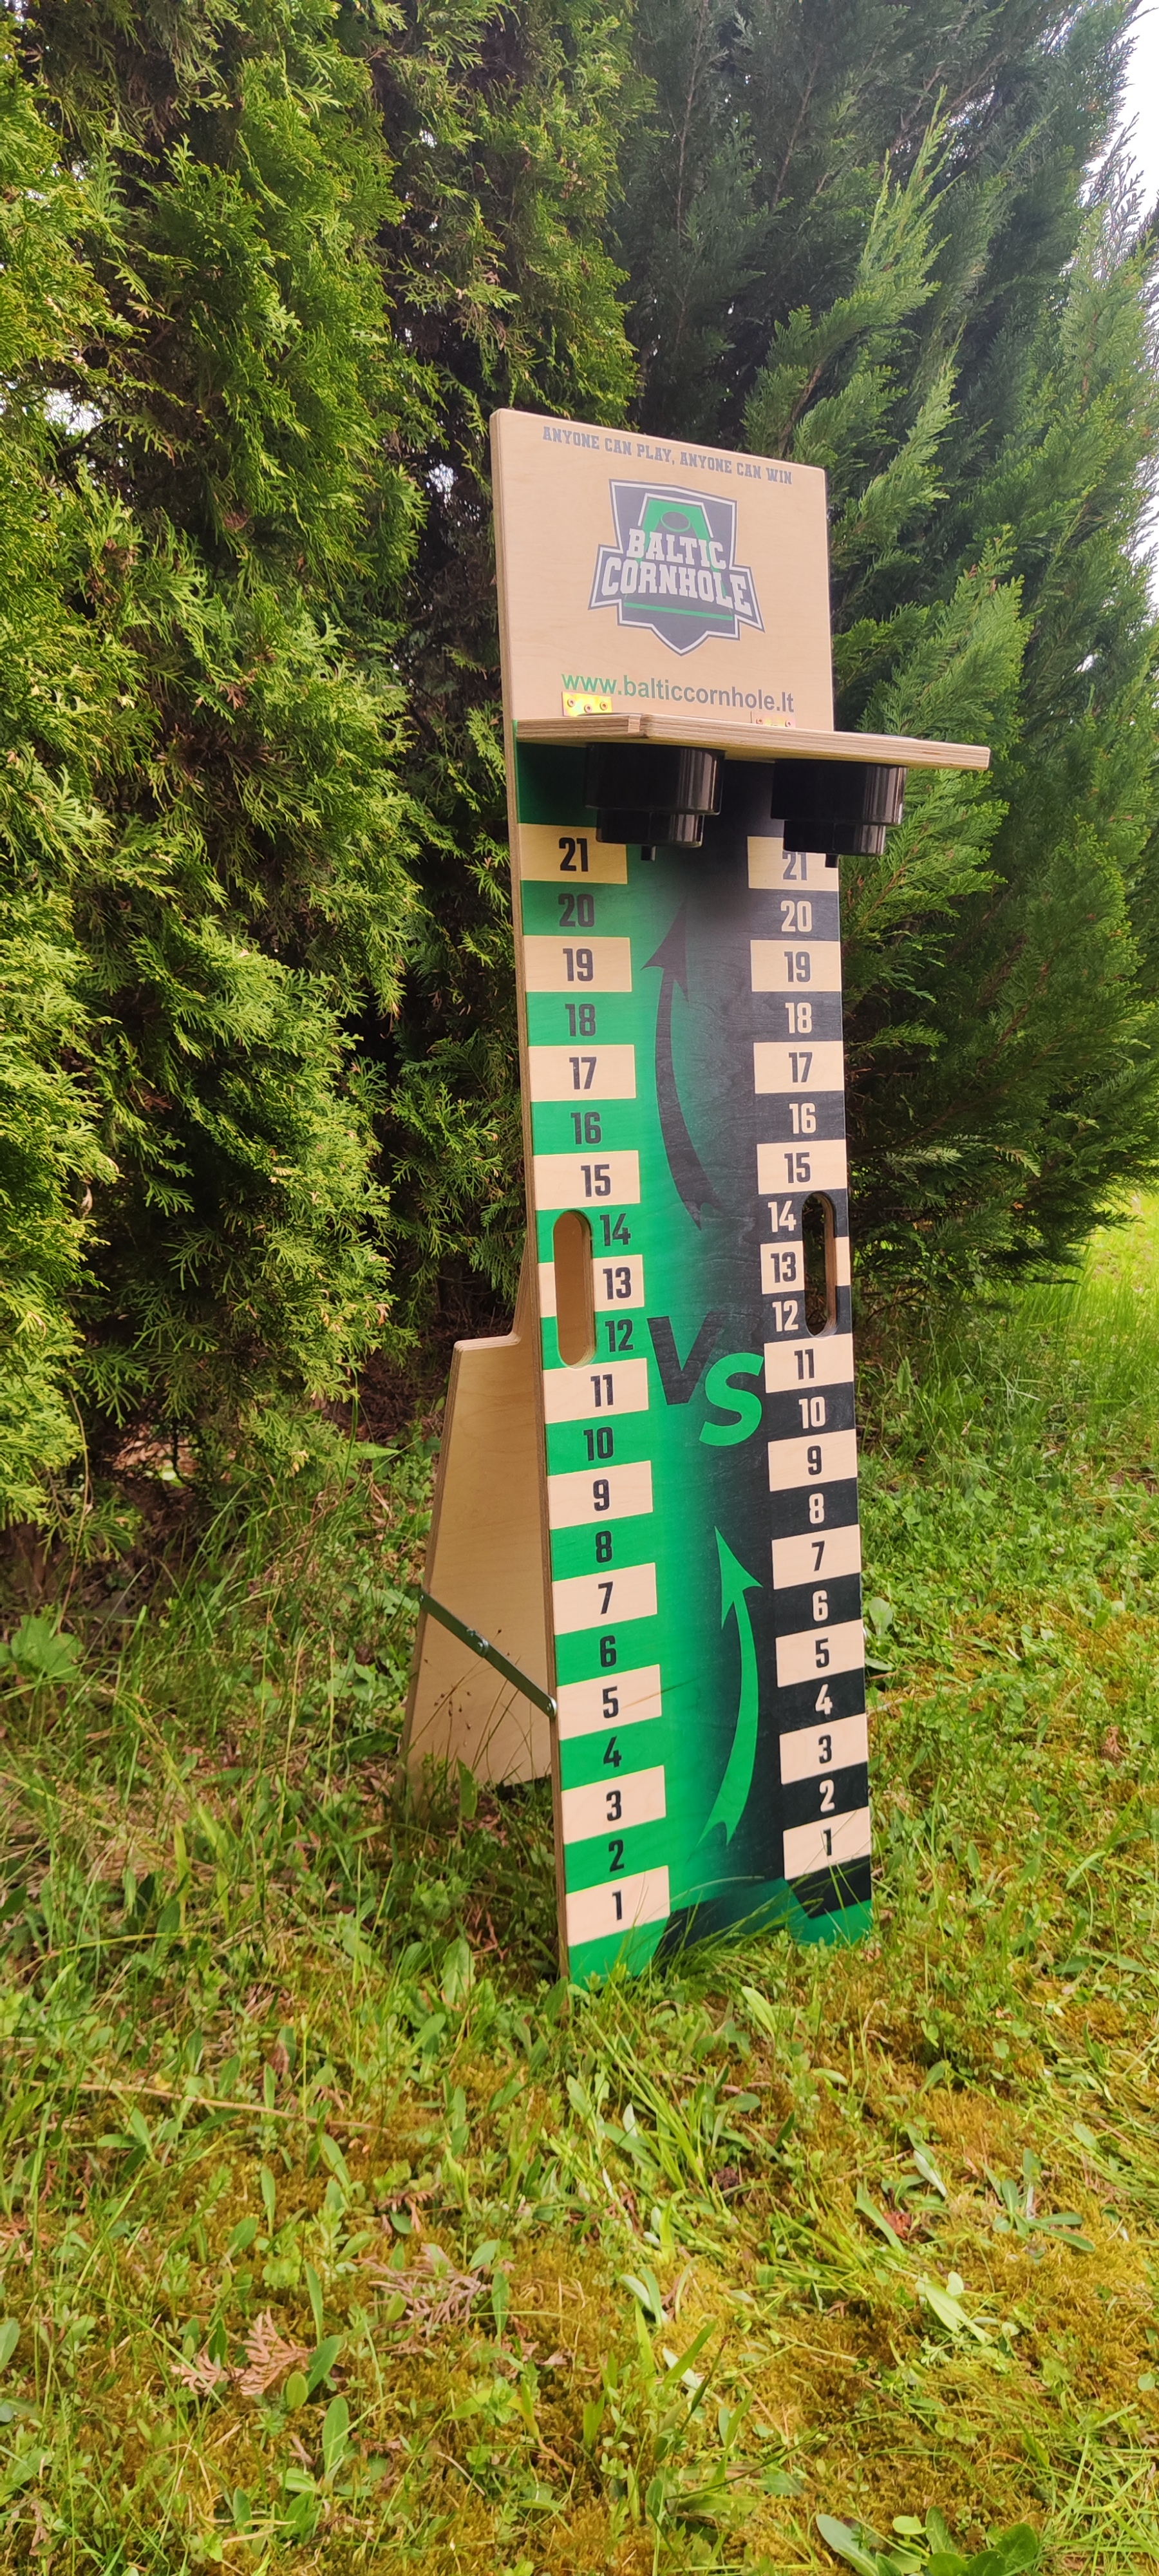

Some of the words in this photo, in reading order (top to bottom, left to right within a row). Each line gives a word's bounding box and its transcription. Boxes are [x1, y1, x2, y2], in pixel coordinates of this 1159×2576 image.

[542, 426, 600, 450] ANYONE
[605, 437, 632, 456] CAN
[636, 443, 675, 466] PLAY,
[679, 451, 733, 475] ANYONE
[736, 462, 762, 480] CAN
[766, 468, 793, 485] WIN
[626, 527, 726, 571] BALTIC
[601, 556, 753, 617] CORNHOLE
[561, 673, 795, 713] www.balticcornhole.lt
[558, 837, 588, 871] 21
[782, 851, 808, 880] 21
[558, 893, 594, 927] 20
[780, 900, 812, 932] 20
[563, 948, 594, 982] 19
[784, 951, 811, 983] 19
[565, 1003, 596, 1036] 18
[785, 1002, 812, 1034] 18
[569, 1057, 597, 1090] 17
[788, 1051, 813, 1083] 17
[570, 1112, 601, 1144] 16
[789, 1103, 816, 1134] 16
[581, 1164, 611, 1197] 15
[784, 1152, 811, 1183] 15
[599, 1213, 631, 1246] 14
[768, 1200, 796, 1232] 14
[603, 1266, 632, 1300] 13
[771, 1251, 796, 1282] 13
[773, 1300, 798, 1331] 12
[604, 1319, 634, 1352] 12
[646, 1314, 764, 1446] VS
[794, 1349, 815, 1380] 11
[590, 1374, 614, 1407] 11
[798, 1396, 825, 1429] 10
[583, 1426, 613, 1461] 10
[807, 1444, 822, 1476] 9
[593, 1479, 610, 1512] 9
[809, 1492, 825, 1524] 8
[596, 1530, 612, 1563] 8
[811, 1540, 825, 1571] 7
[597, 1582, 614, 1615] 7
[812, 1590, 829, 1622] 6
[599, 1634, 617, 1667] 6
[815, 1637, 830, 1669] 5
[602, 1685, 619, 1719] 5
[815, 1683, 833, 1715] 4
[603, 1736, 622, 1767] 4
[817, 1734, 833, 1764] 3
[606, 1790, 622, 1821] 3
[819, 1779, 835, 1812] 2
[608, 1839, 625, 1872] 2
[822, 1828, 833, 1856] 1
[612, 1889, 623, 1921] 1
